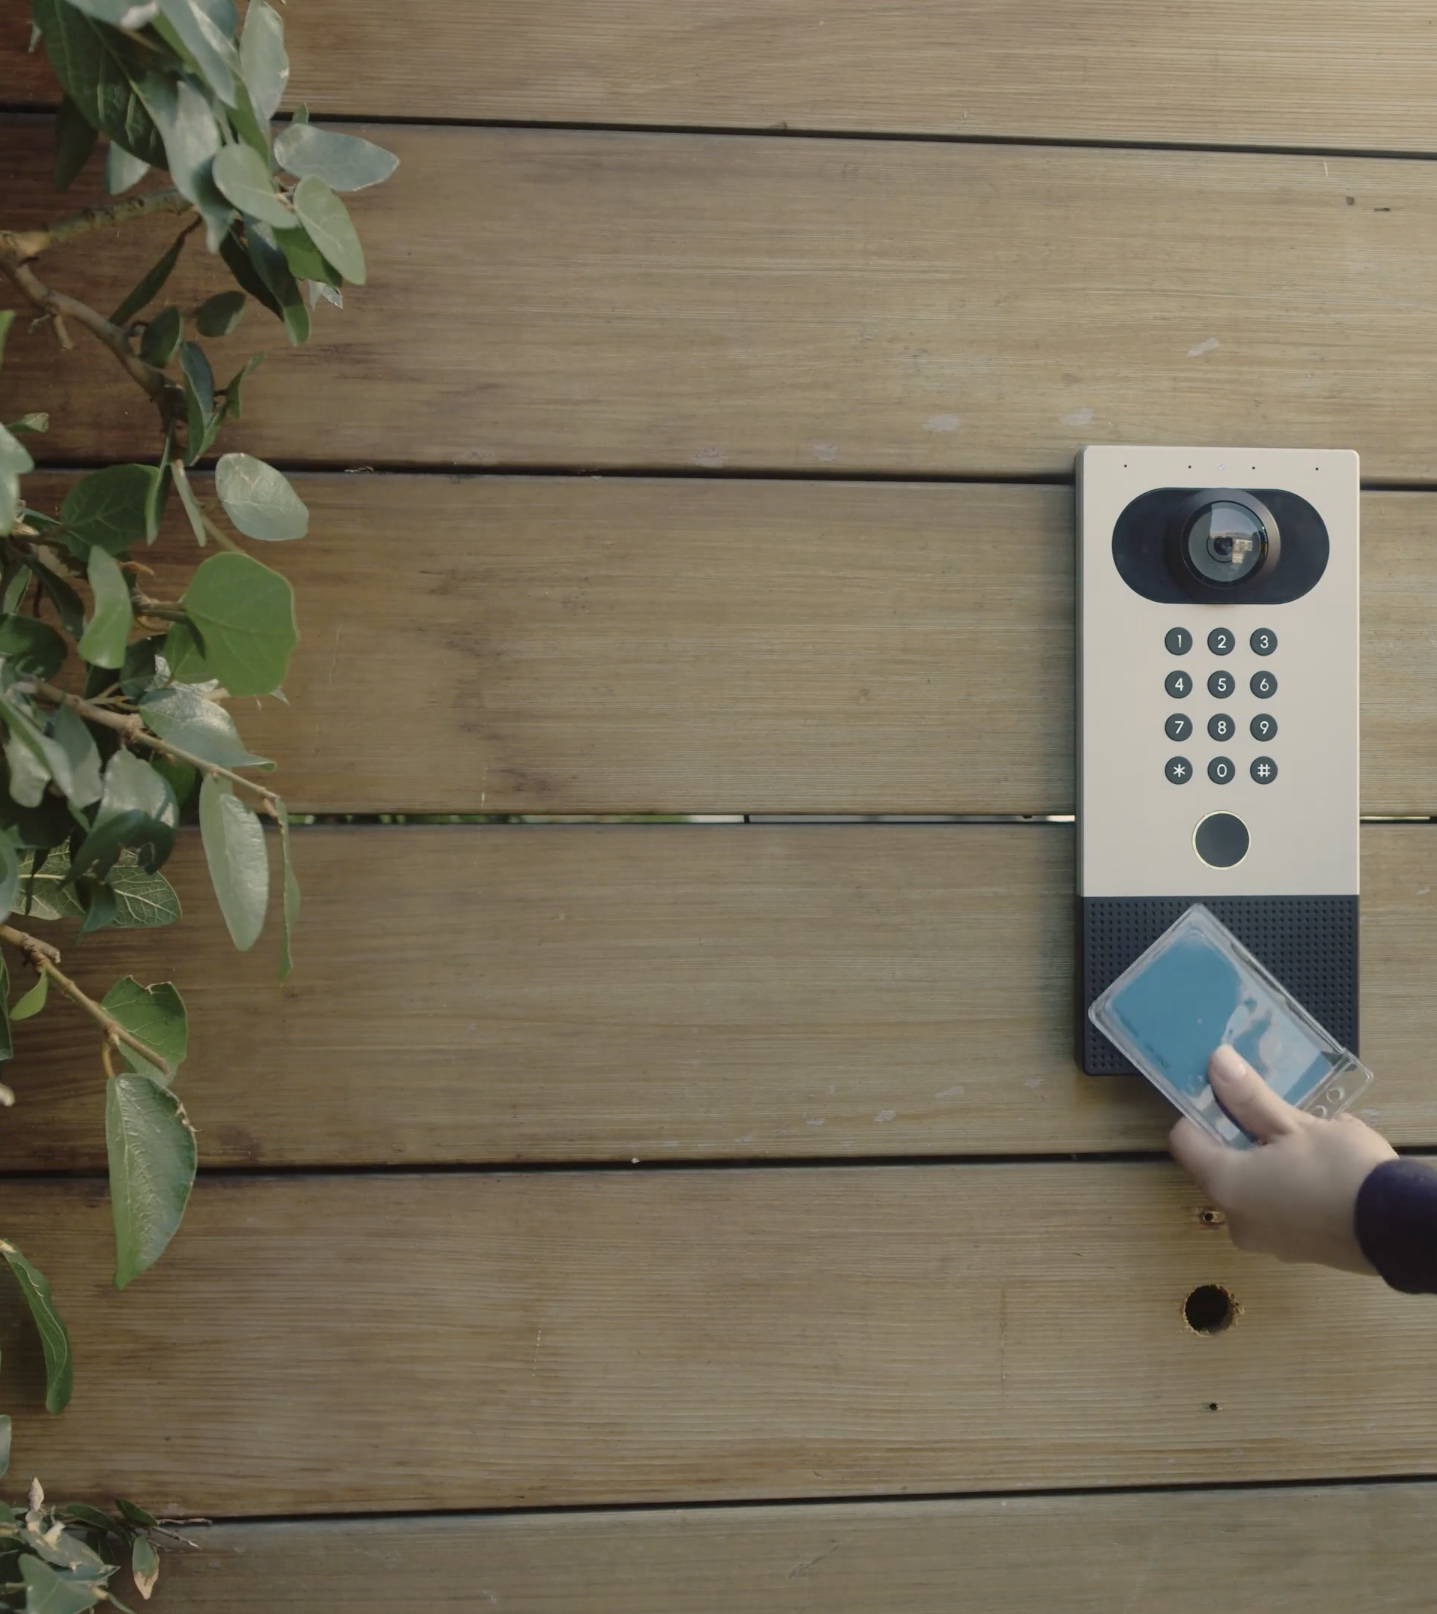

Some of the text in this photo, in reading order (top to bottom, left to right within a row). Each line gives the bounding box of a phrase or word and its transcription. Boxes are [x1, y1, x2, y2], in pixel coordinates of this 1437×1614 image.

[1217, 634, 1227, 649] 2
[1259, 634, 1269, 649] 3
[1174, 677, 1270, 692] 4 5 6
[1174, 720, 1270, 735] 7 8 9
[1216, 763, 1228, 778] 0
[1257, 763, 1271, 778] #
